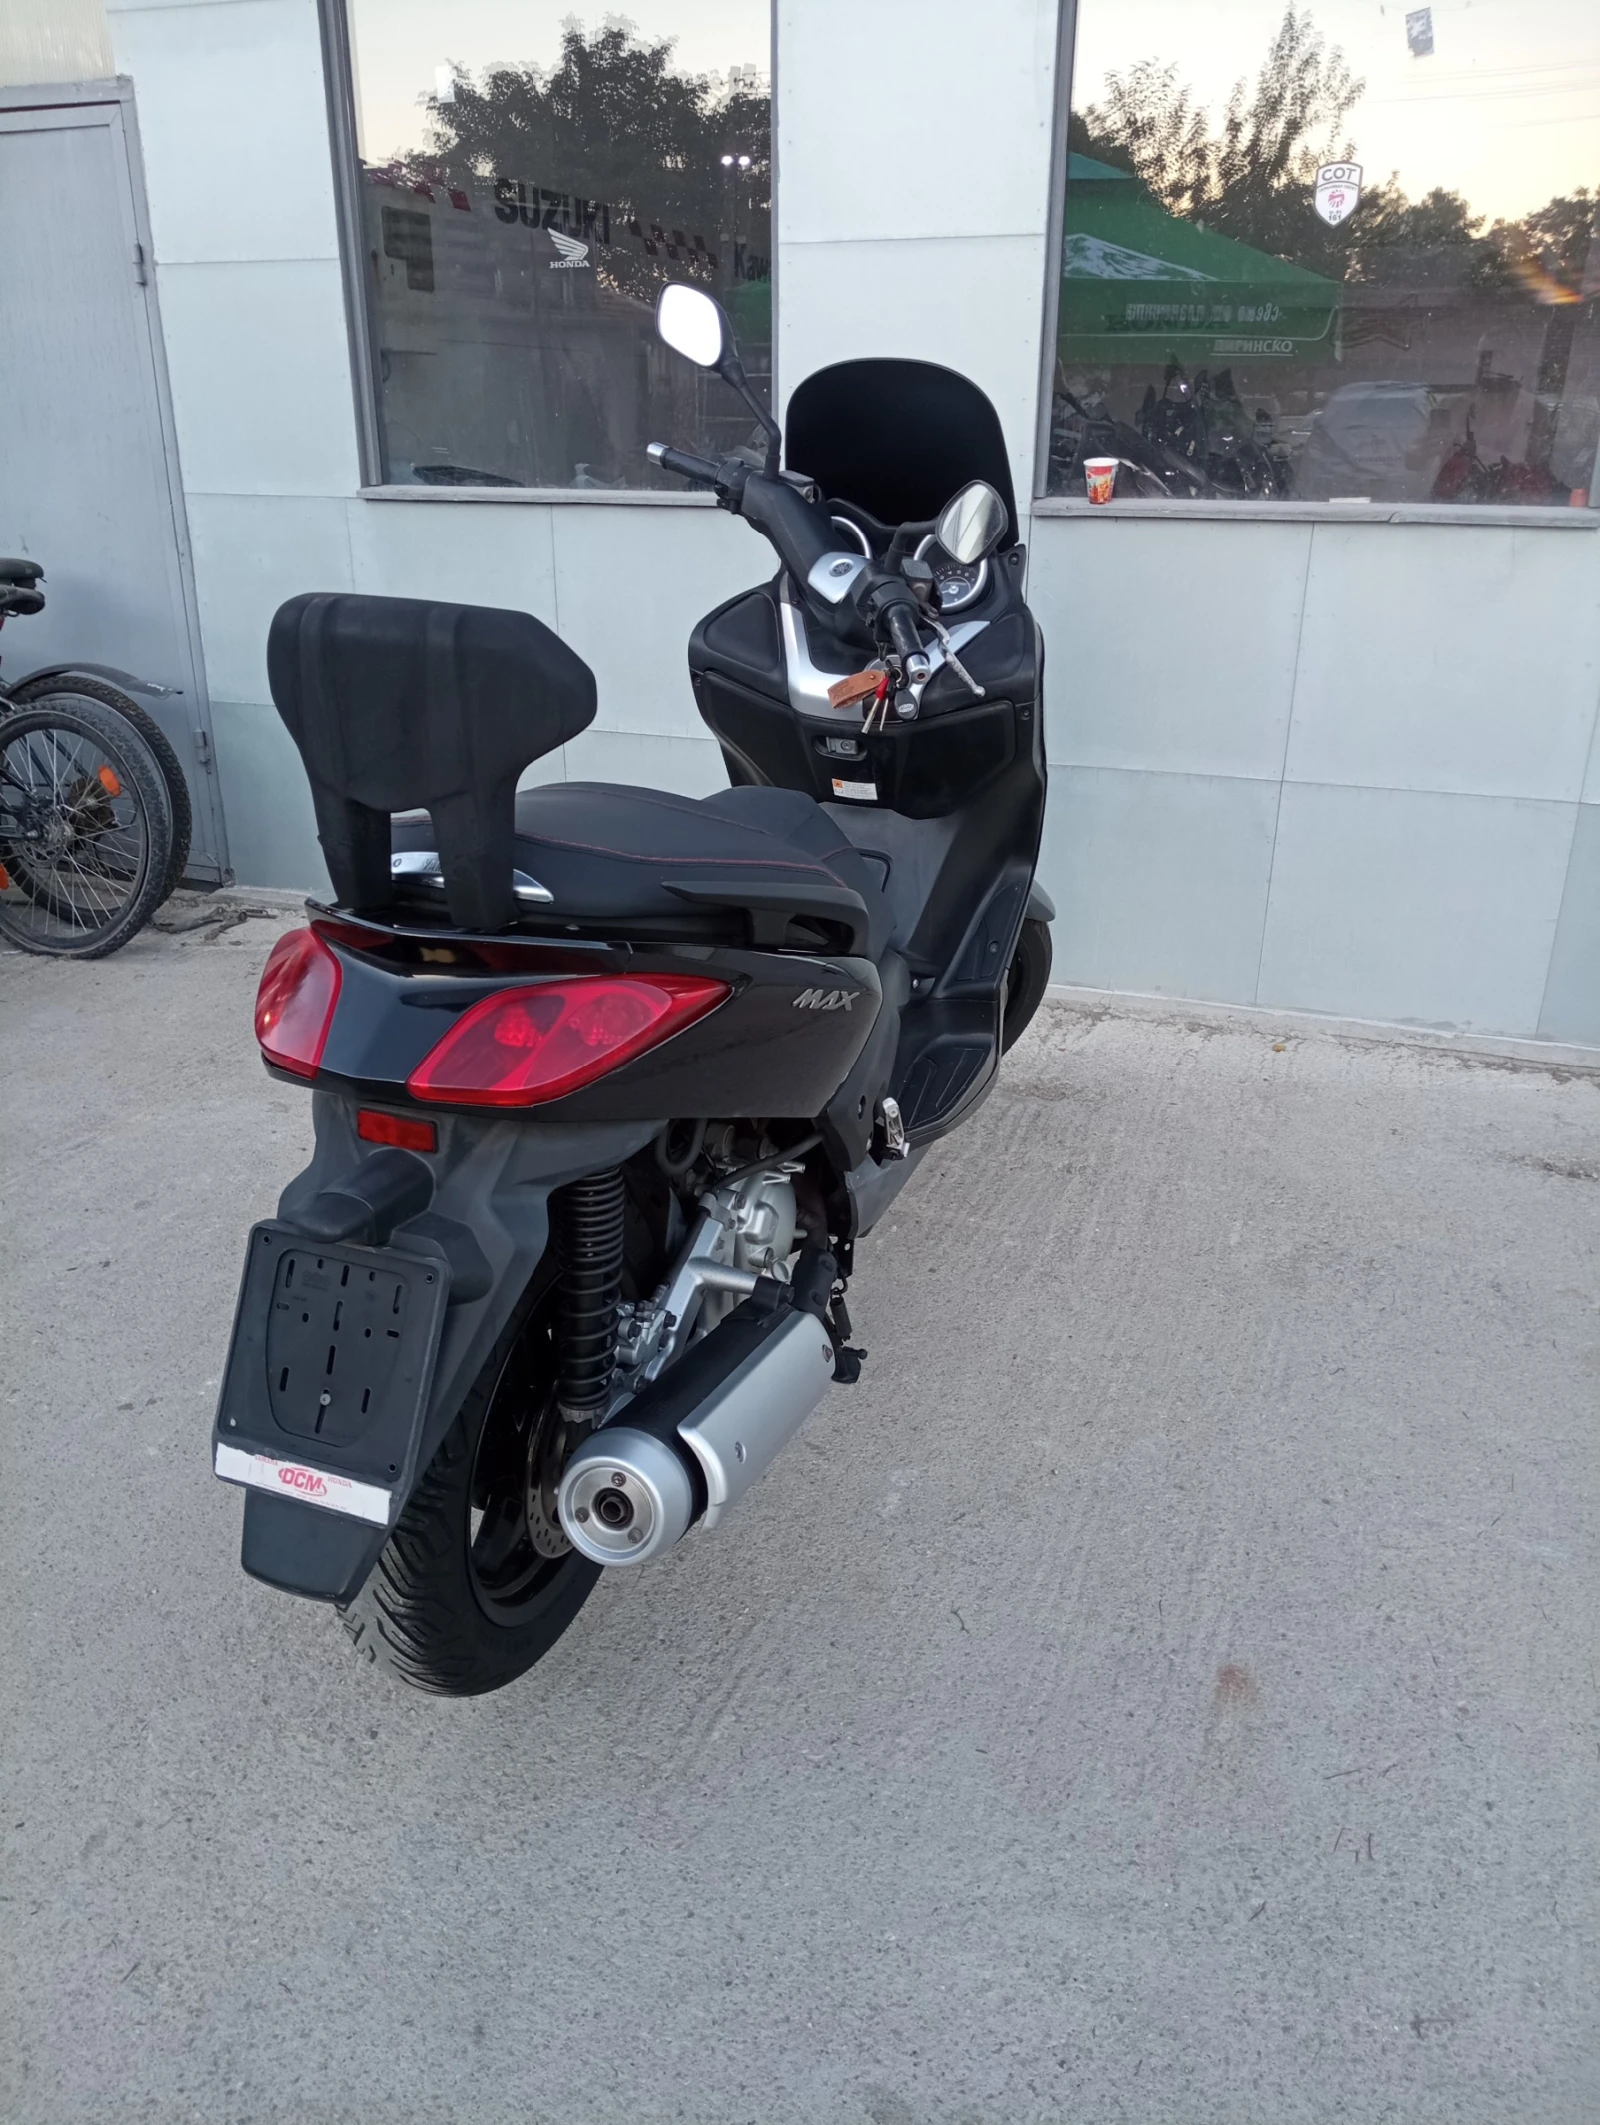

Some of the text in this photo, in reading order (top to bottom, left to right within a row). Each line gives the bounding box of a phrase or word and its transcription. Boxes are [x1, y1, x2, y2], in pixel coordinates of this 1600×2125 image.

[494, 178, 610, 244] SUZUKI
[550, 260, 590, 268] HONDA
[793, 988, 860, 1011] MAX
[281, 1468, 323, 1493] DCM
[327, 1475, 353, 1489] HONDA
